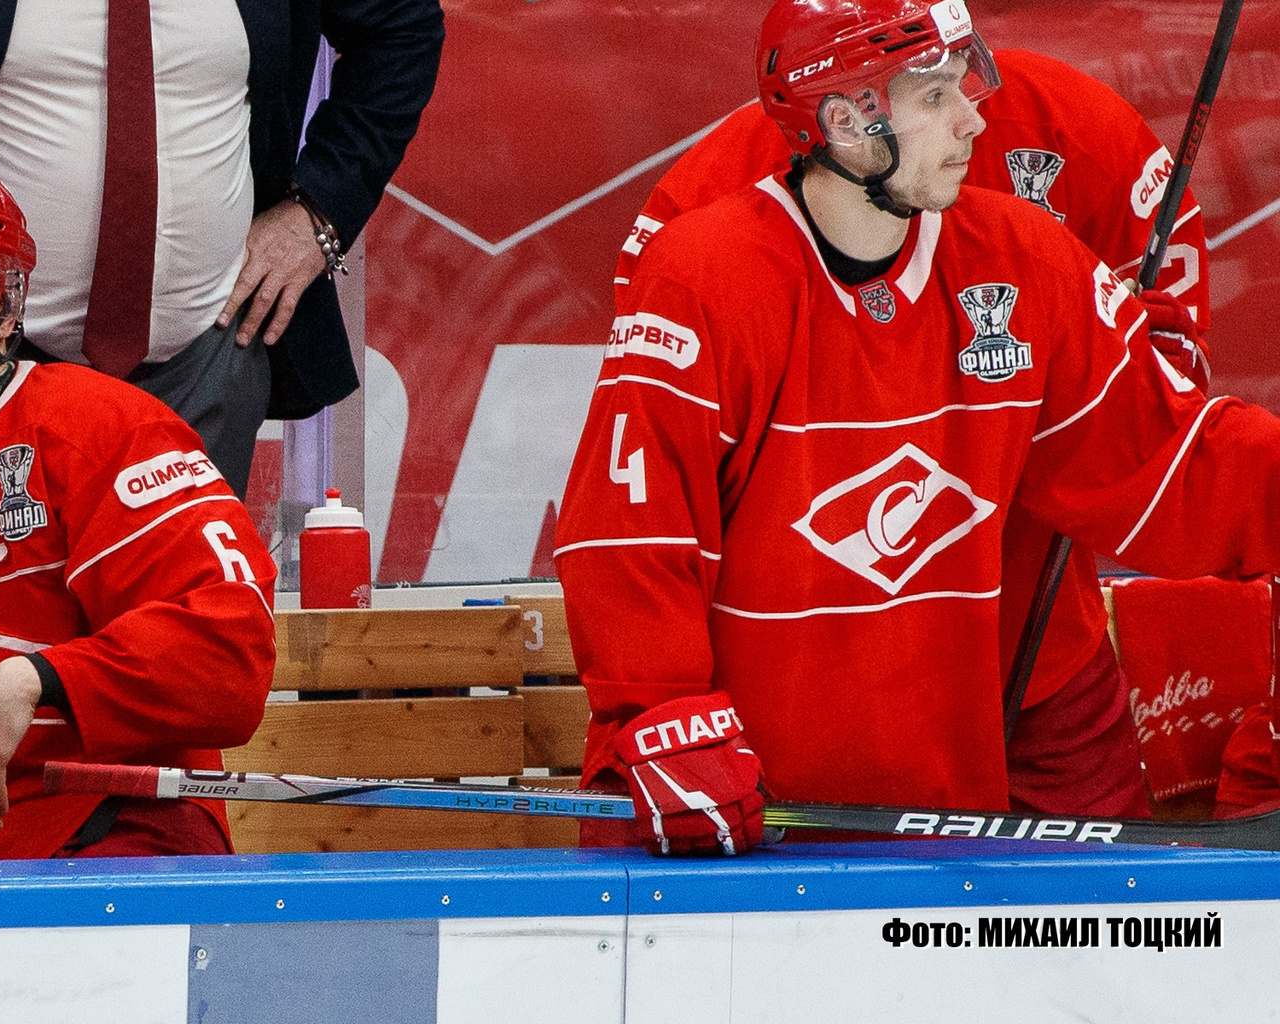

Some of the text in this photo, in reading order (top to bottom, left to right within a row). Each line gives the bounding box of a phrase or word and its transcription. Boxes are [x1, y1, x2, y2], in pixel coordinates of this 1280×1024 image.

[788, 56, 835, 83] CCM
[608, 324, 689, 355] OLIPBET
[961, 345, 1030, 372] ФИНАЛ
[609, 413, 647, 504] 4
[127, 459, 214, 494] OLIMPET
[202, 520, 257, 583] 6
[522, 610, 543, 651] 3
[177, 783, 240, 796] BAUER
[895, 812, 1123, 844] BAUER
